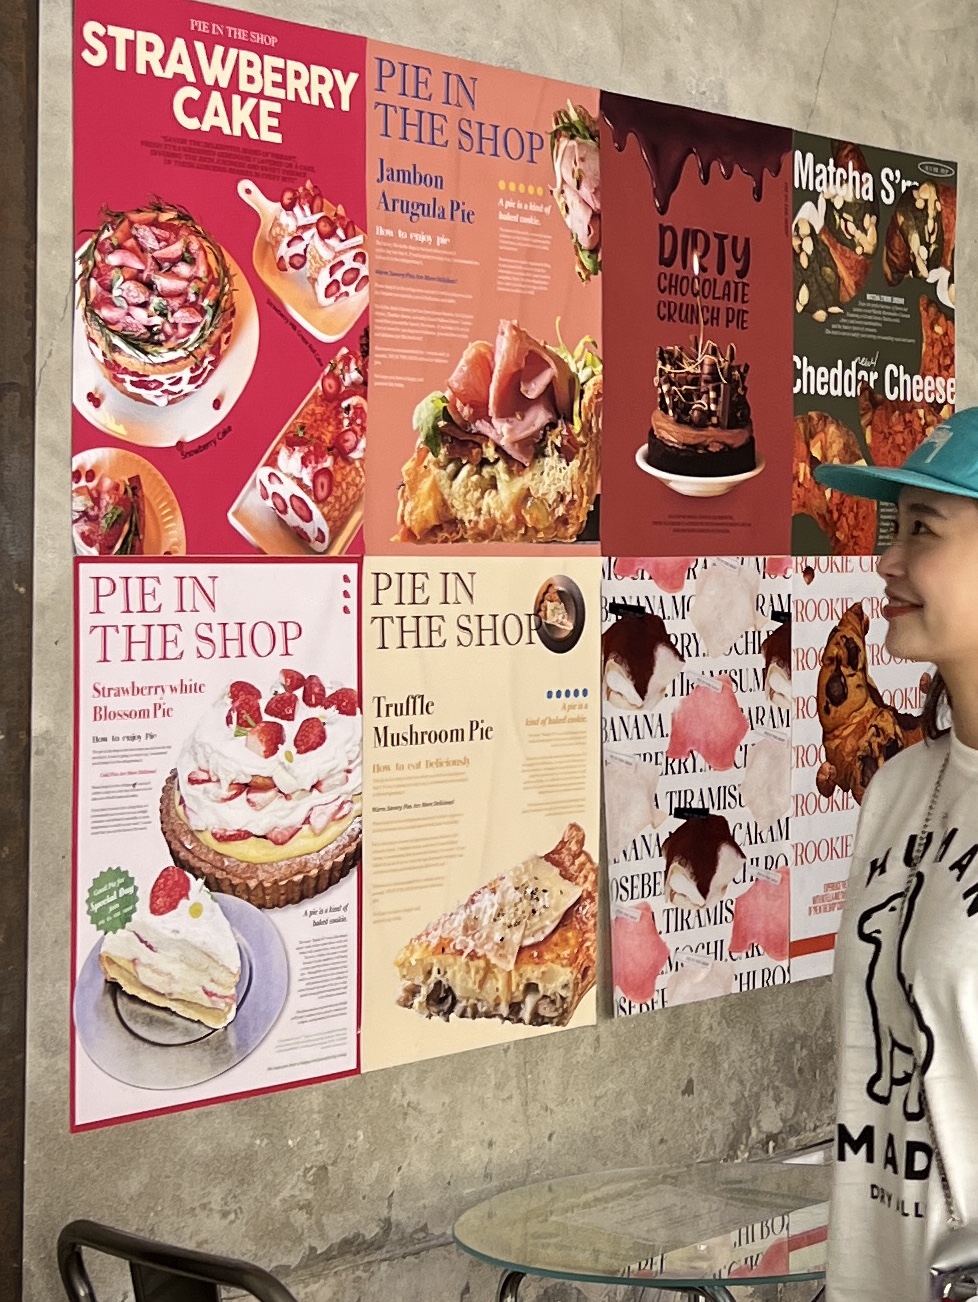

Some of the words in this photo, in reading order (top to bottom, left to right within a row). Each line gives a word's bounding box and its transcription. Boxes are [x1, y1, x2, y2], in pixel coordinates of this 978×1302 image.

[190, 18, 210, 34] PIE
[211, 22, 224, 36] IN
[226, 25, 248, 41] THE
[250, 28, 278, 47] SHOP
[81, 20, 359, 112] STRAWBERRY
[374, 56, 433, 102] PIE
[441, 71, 478, 111] IN
[172, 86, 282, 143] CAKE
[374, 101, 449, 148] THE
[457, 117, 545, 164] SHOP
[376, 157, 444, 190] Jambon
[794, 149, 874, 202] Matcha
[376, 189, 446, 224] Arugula
[450, 199, 476, 225] Pie
[658, 223, 751, 279] DIRTY
[657, 272, 751, 304] CHOCOLATE
[657, 300, 720, 328] CRUNCH
[725, 306, 749, 330] PIE
[793, 354, 878, 398] Cheddar
[884, 363, 956, 405] Cheese
[88, 575, 163, 615] PIE
[174, 575, 219, 614] IN
[370, 571, 431, 606] PIE
[439, 571, 477, 605] IN
[88, 622, 185, 663] THE
[195, 620, 303, 660] SHOP
[370, 614, 447, 650] THE
[456, 612, 543, 647] SHOP
[92, 681, 167, 700] Strawberry
[169, 678, 206, 697] white
[372, 694, 435, 718] Truffle
[92, 703, 151, 722] Blossom
[153, 702, 174, 719] Pie
[373, 724, 465, 749] Mushroom
[468, 719, 494, 742] Pie
